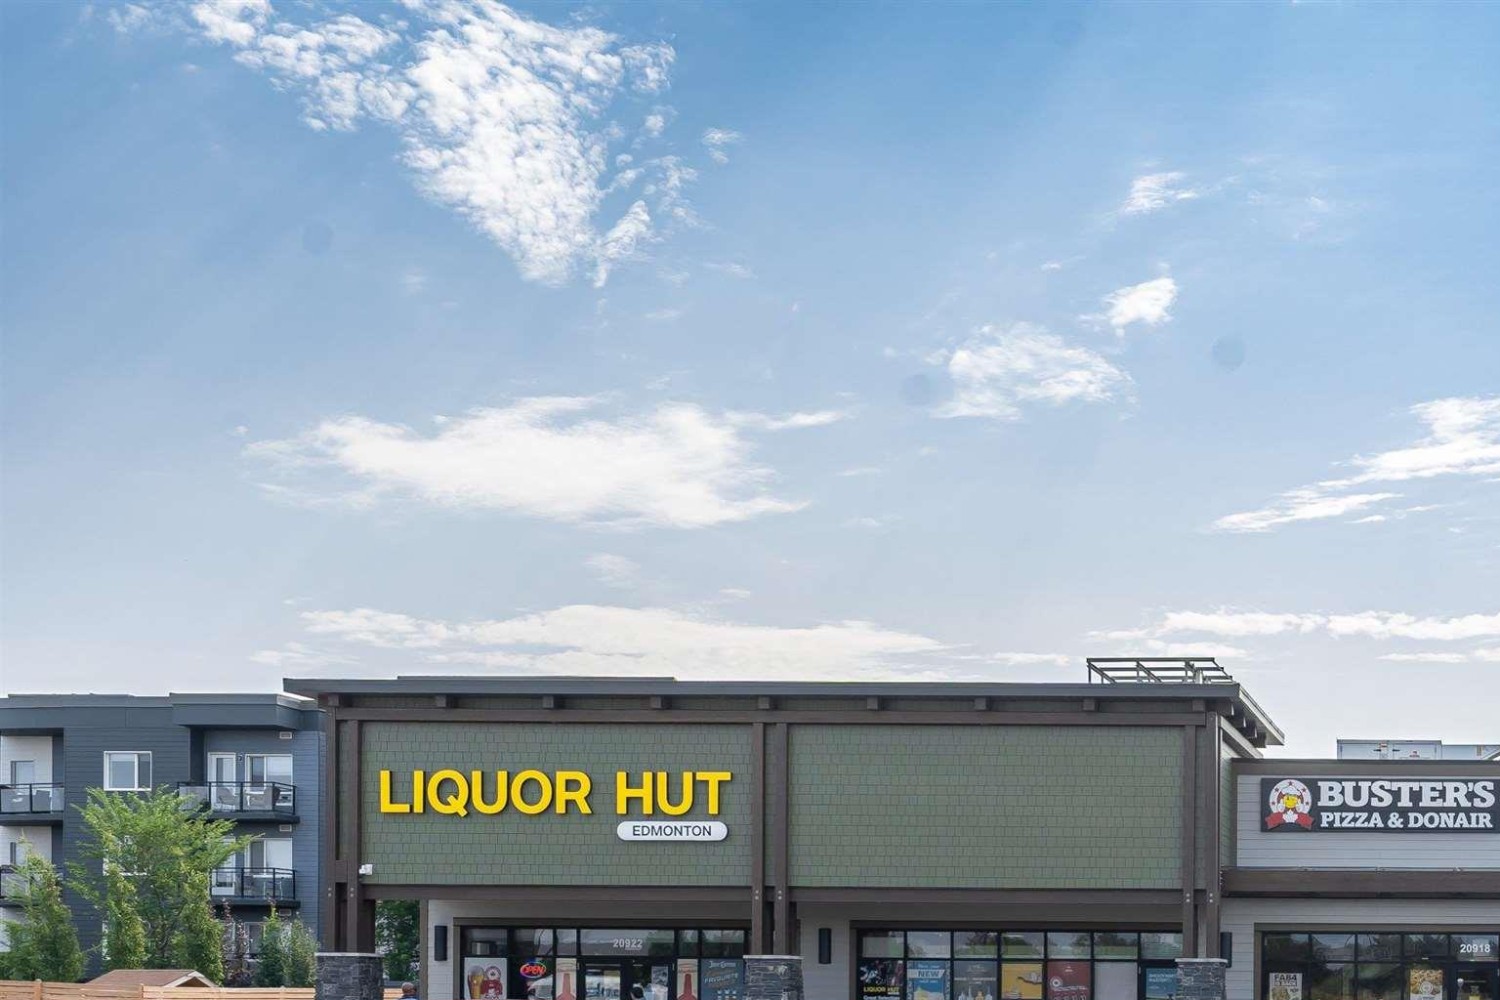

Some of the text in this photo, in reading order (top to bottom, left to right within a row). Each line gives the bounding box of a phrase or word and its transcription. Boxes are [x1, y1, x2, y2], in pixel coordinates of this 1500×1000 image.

[379, 768, 733, 818] LIQUOR HUT
[1317, 780, 1496, 809] BUSTER'S
[1320, 811, 1494, 829] PIZZA & DONAIR
[632, 824, 713, 838] EDMONTON
[612, 938, 643, 948] 20922
[1459, 943, 1491, 954] 20918
[523, 965, 546, 976] OPEN
